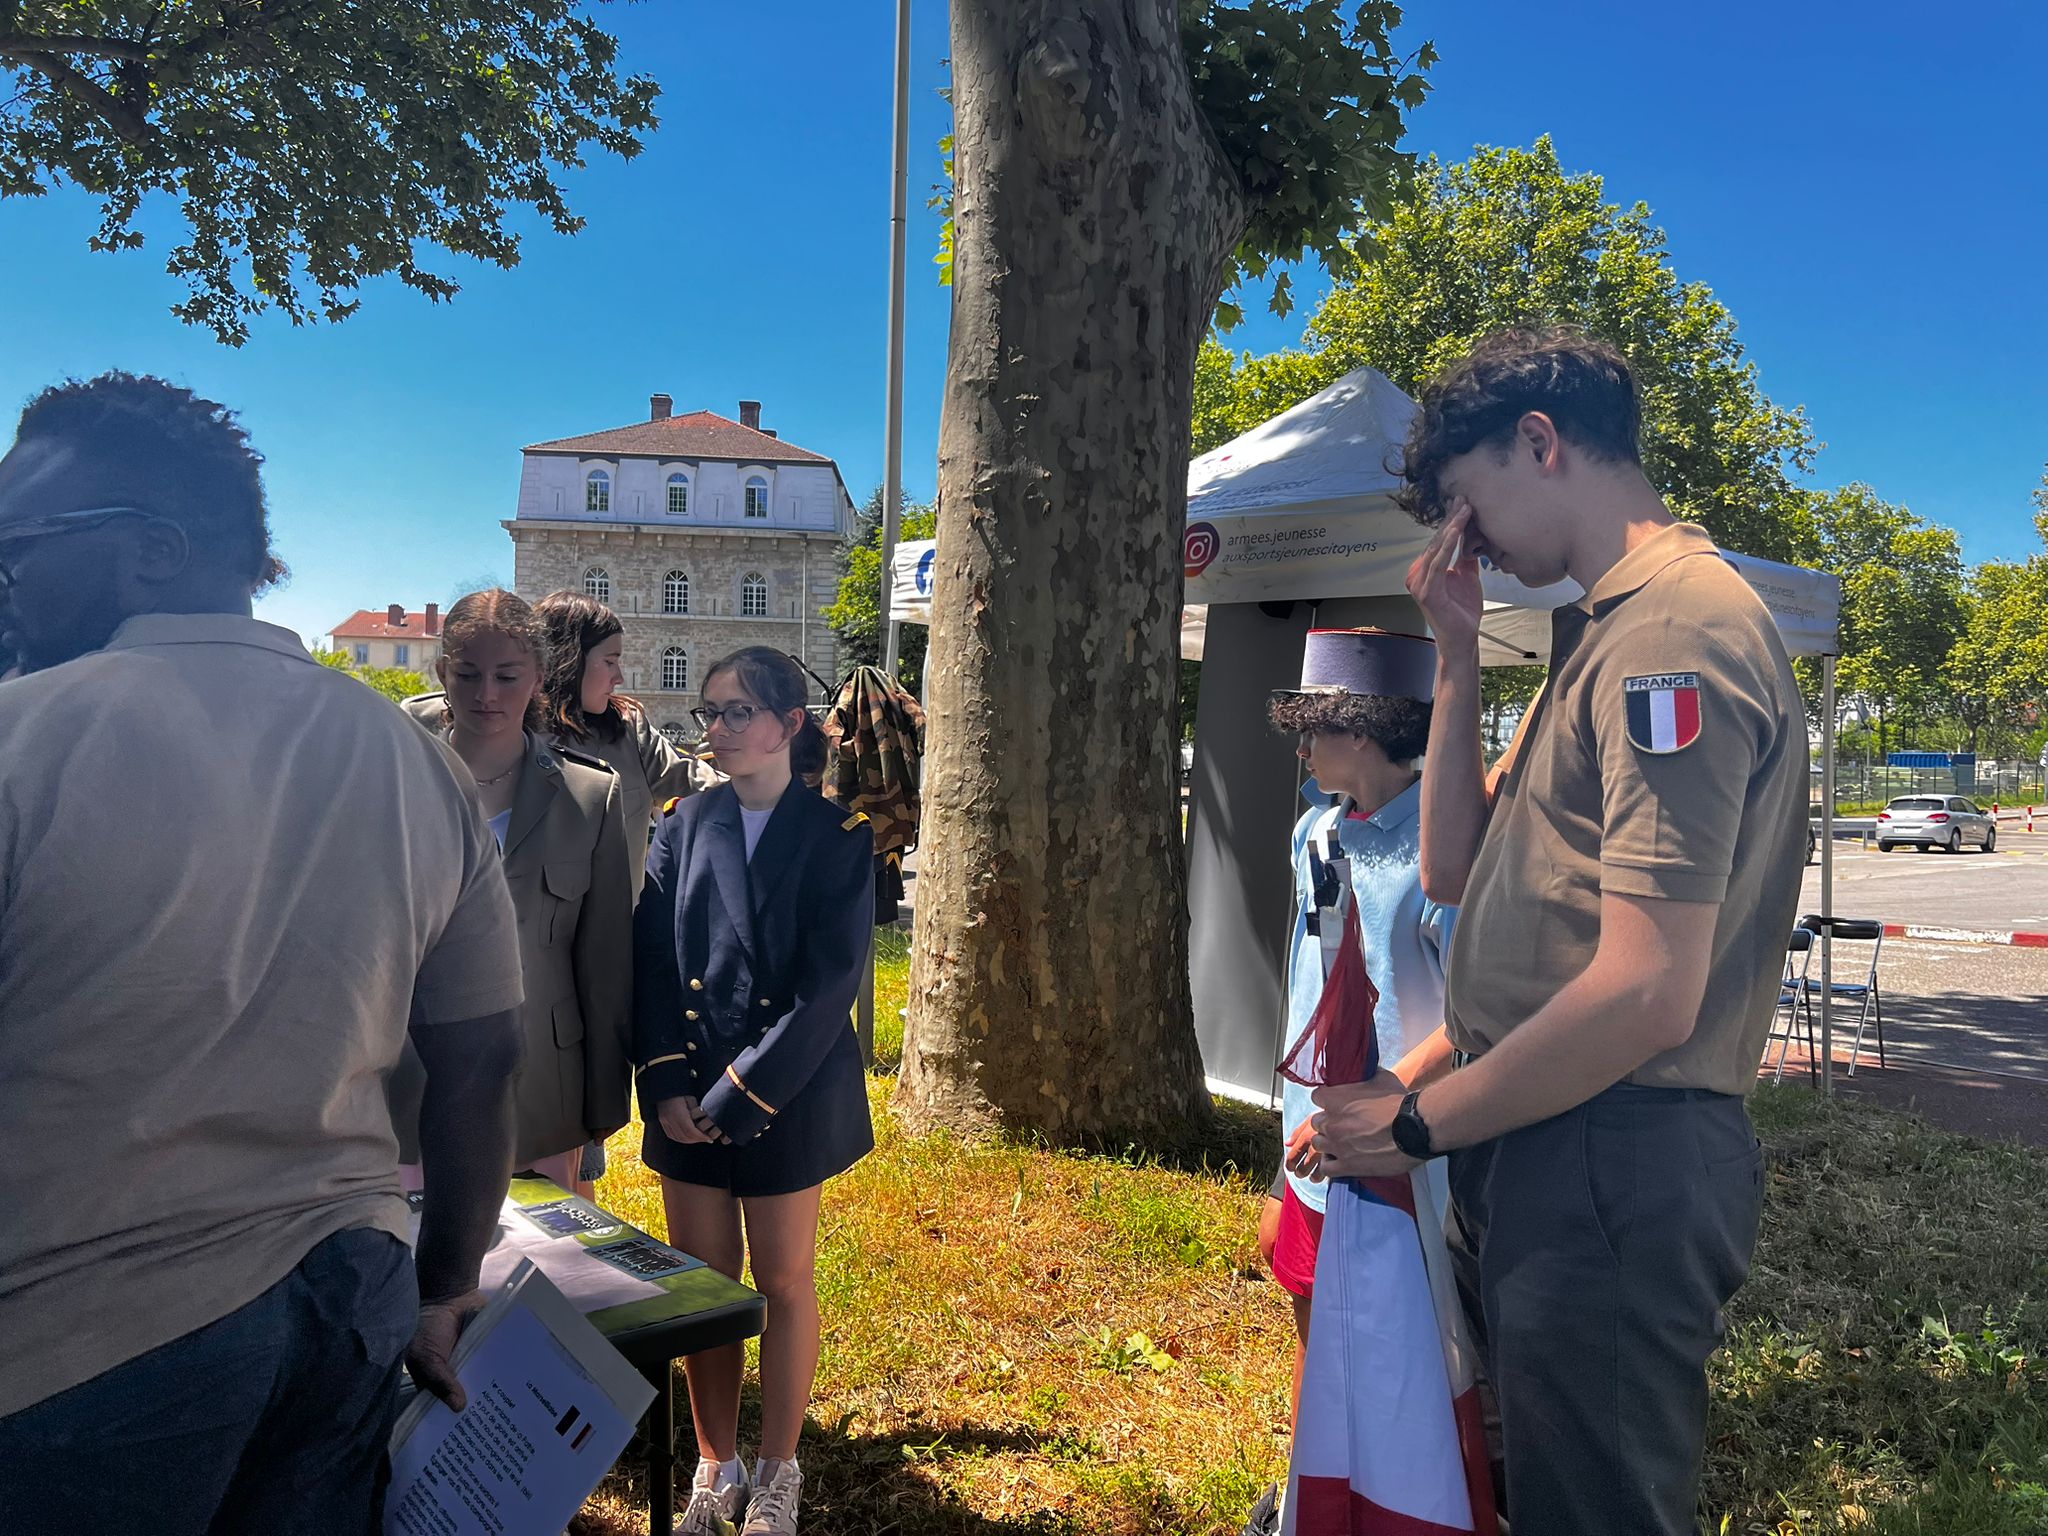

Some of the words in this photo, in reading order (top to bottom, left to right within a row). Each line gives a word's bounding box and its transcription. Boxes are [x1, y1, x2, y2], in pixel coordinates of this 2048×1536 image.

[1227, 526, 1326, 546] armees.jeunesse
[1222, 540, 1378, 564] auxsportsjeunescitoyens
[1630, 676, 1695, 690] FRANCE
